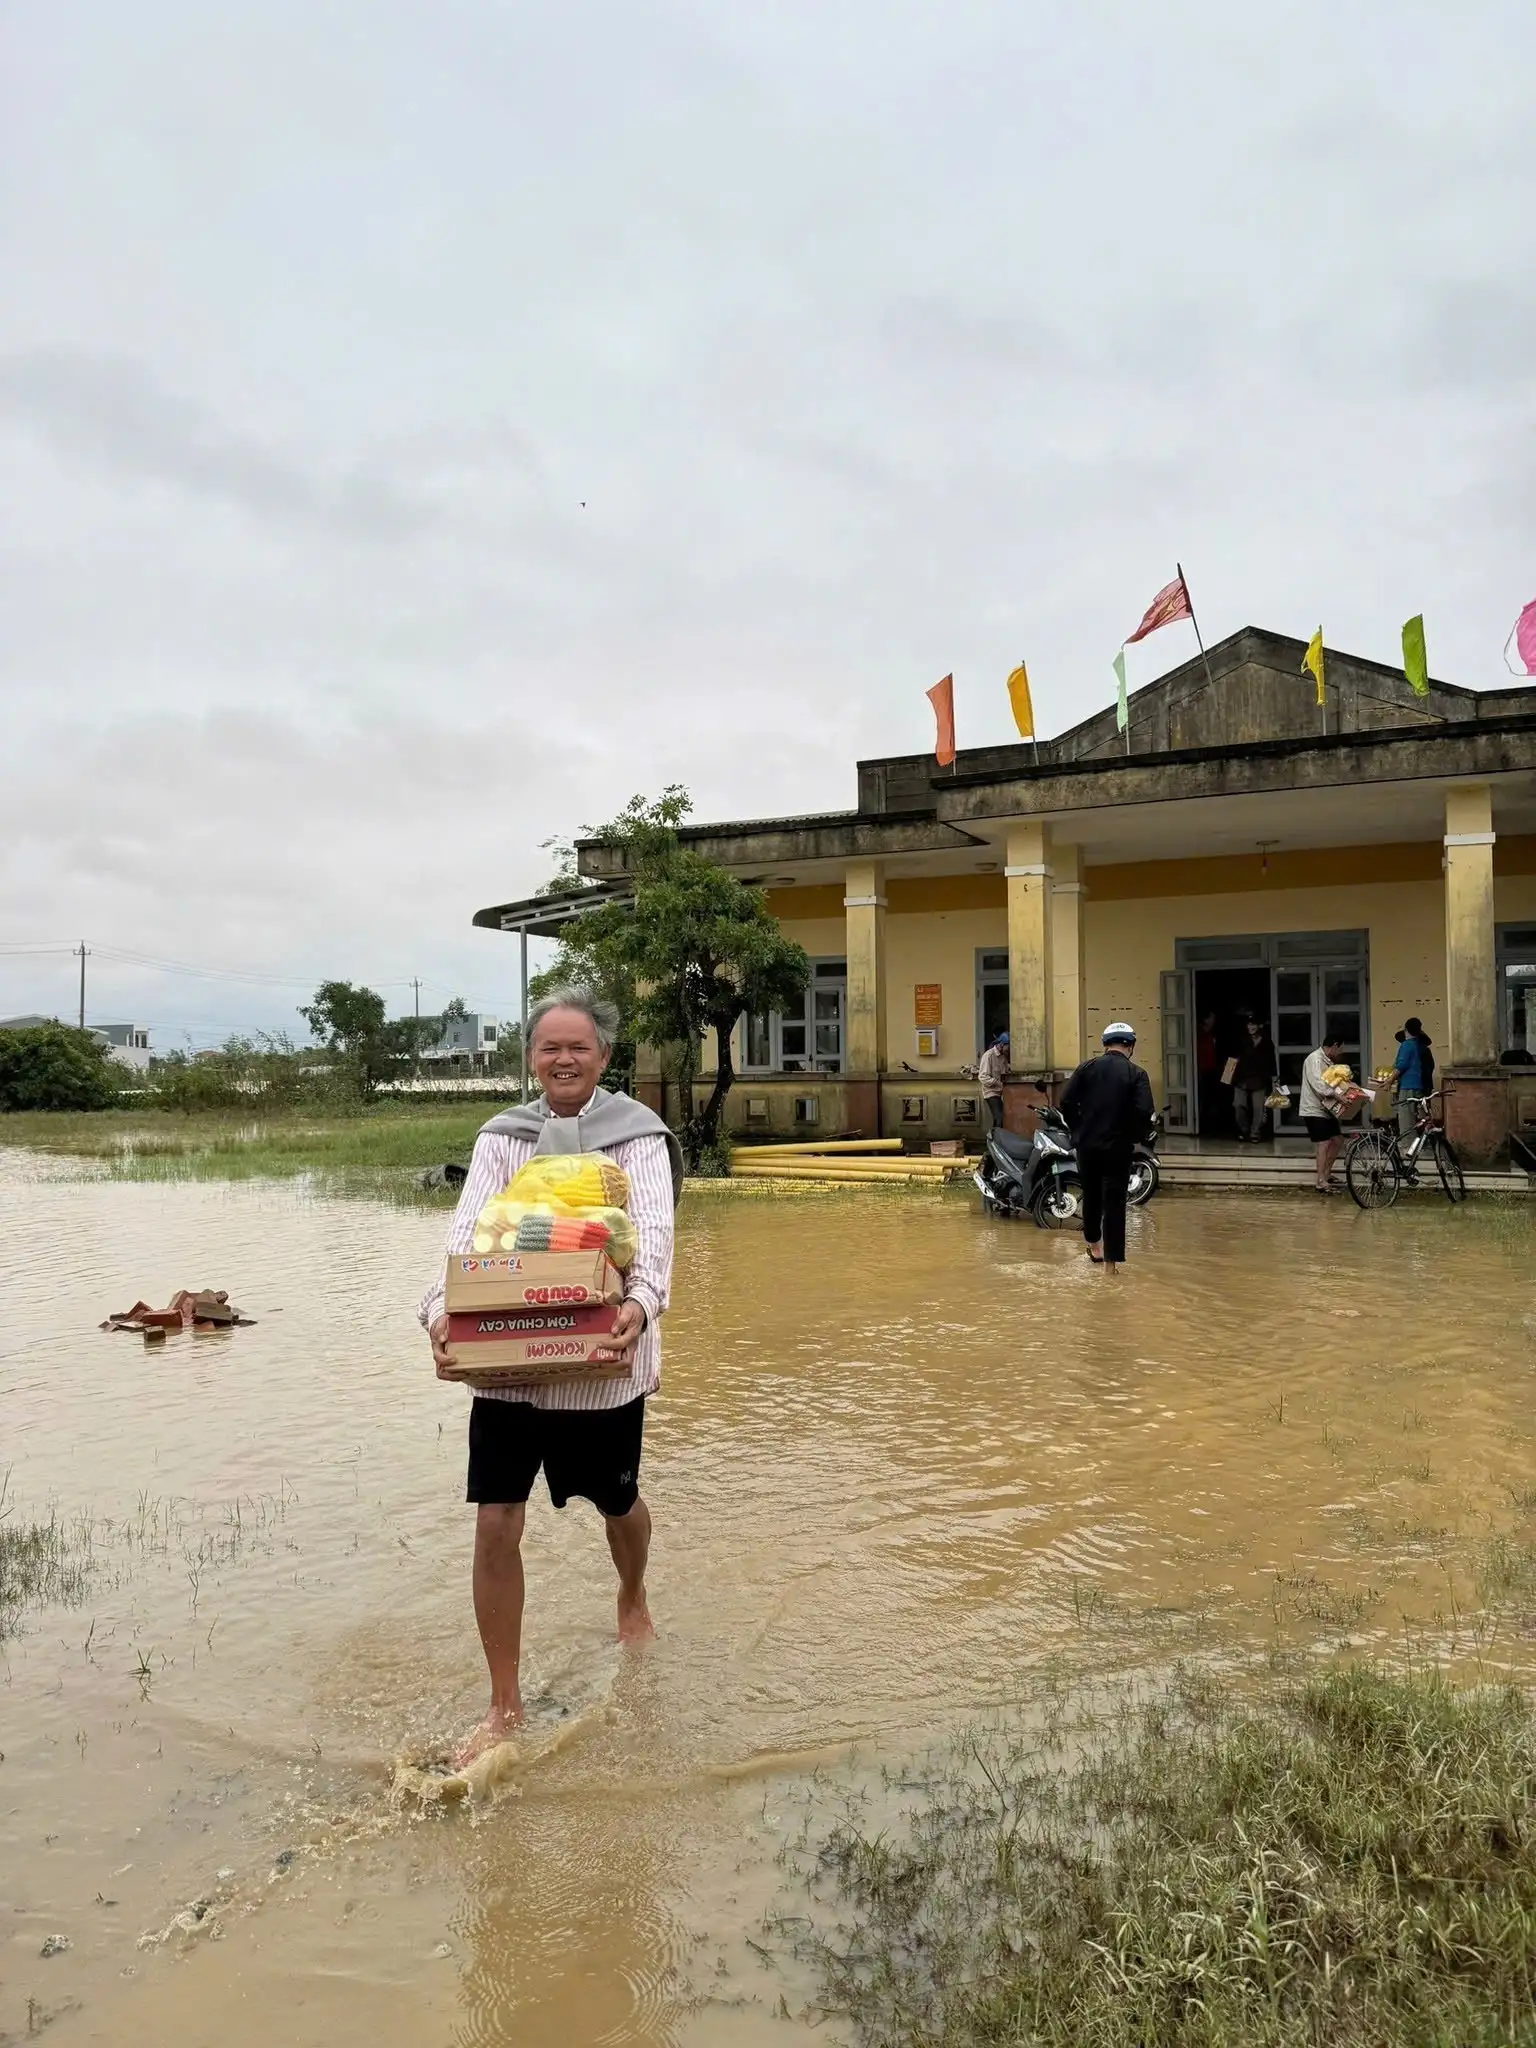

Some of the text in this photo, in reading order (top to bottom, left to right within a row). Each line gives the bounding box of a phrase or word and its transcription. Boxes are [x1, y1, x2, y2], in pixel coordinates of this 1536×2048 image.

[462, 1258, 523, 1272] Tôm và Gà
[477, 1315, 577, 1332] TÔM CHUA CAY
[526, 1342, 586, 1359] KOKOMI
